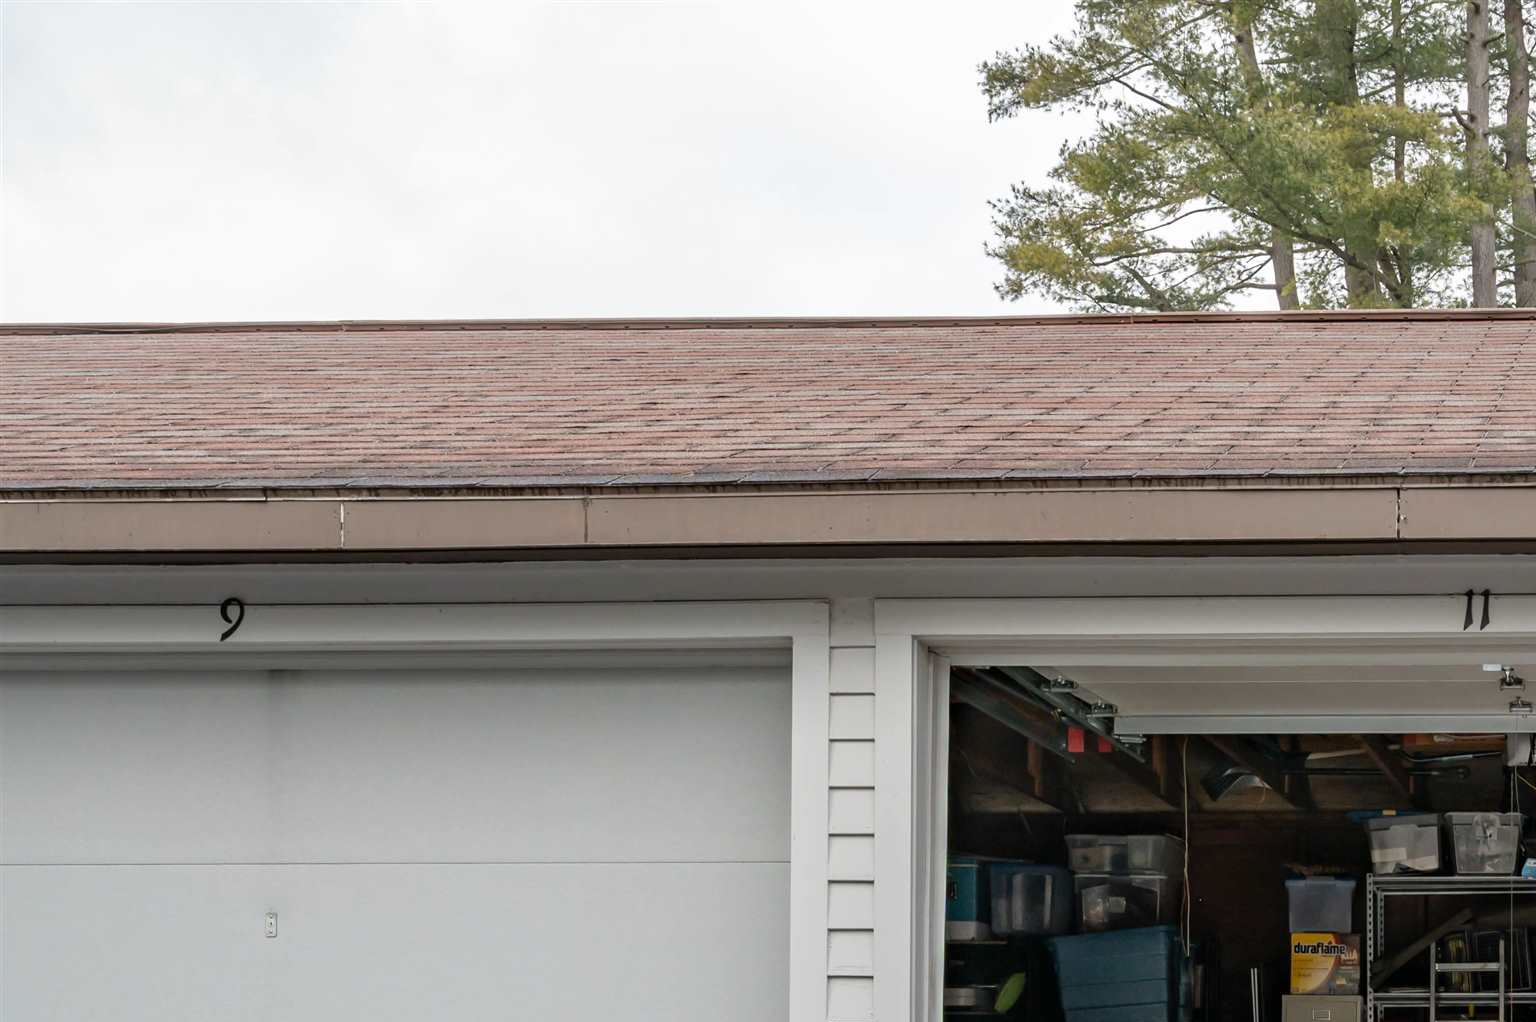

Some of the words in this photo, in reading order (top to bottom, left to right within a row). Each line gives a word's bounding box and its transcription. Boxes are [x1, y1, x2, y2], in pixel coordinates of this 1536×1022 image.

[220, 597, 245, 642] 9
[1463, 589, 1490, 631] 11
[1294, 941, 1346, 954] duraflame
